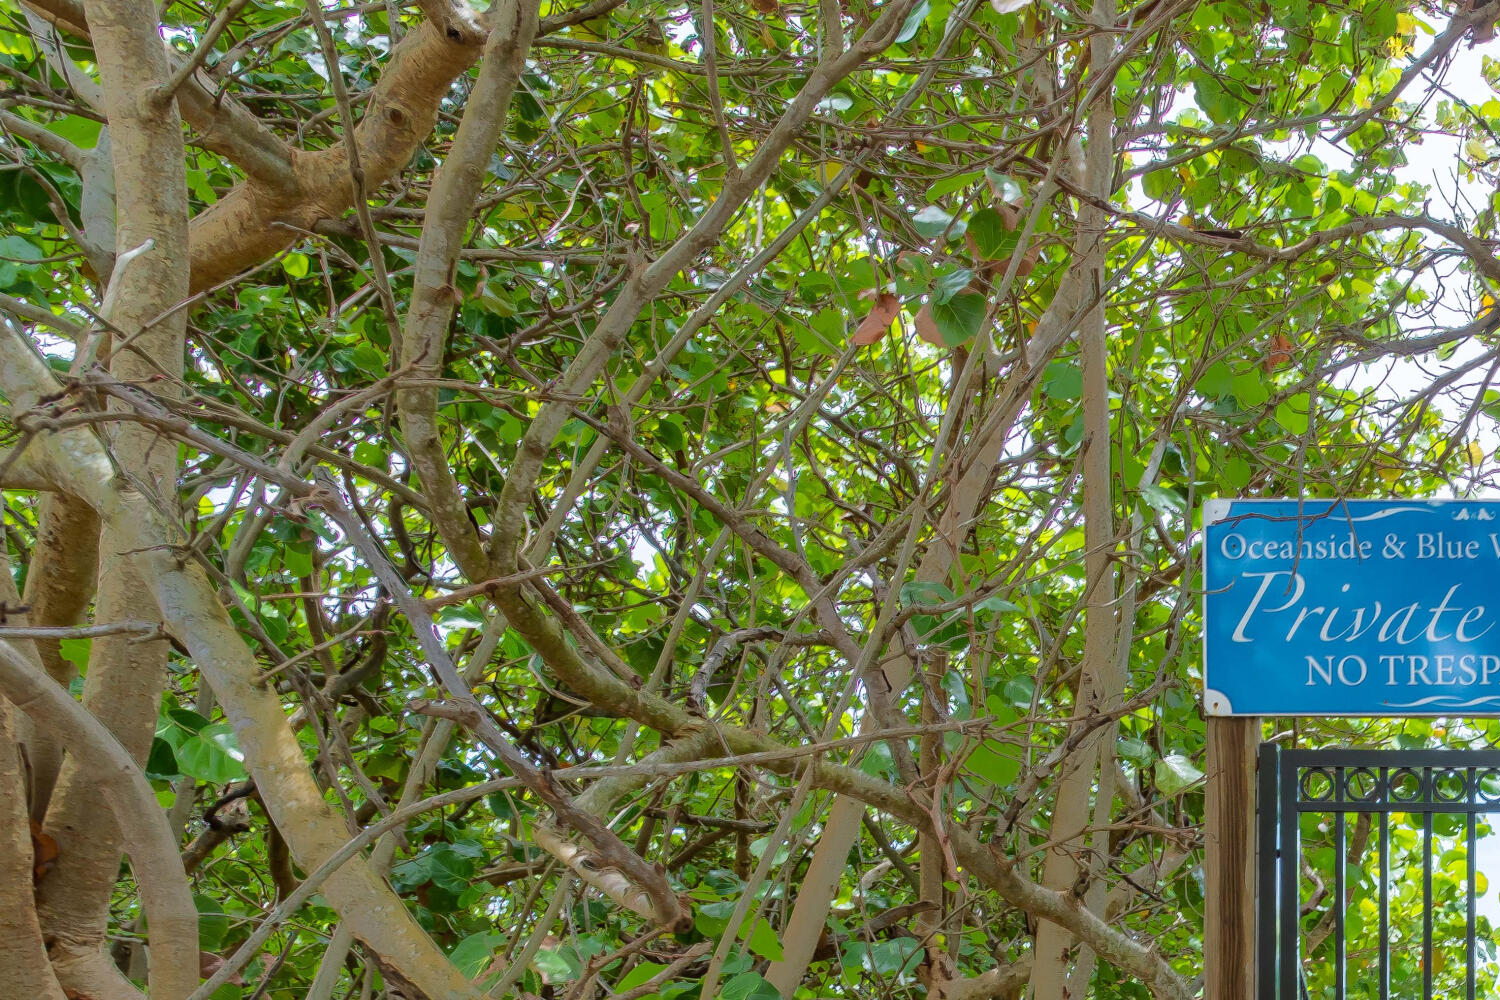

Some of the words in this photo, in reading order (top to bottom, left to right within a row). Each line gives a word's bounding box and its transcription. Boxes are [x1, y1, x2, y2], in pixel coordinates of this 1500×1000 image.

[1221, 532, 1372, 560] Oceanside
[1383, 533, 1406, 560] &
[1417, 533, 1480, 560] Blue
[1231, 571, 1496, 644] Private
[1306, 655, 1367, 686] NO
